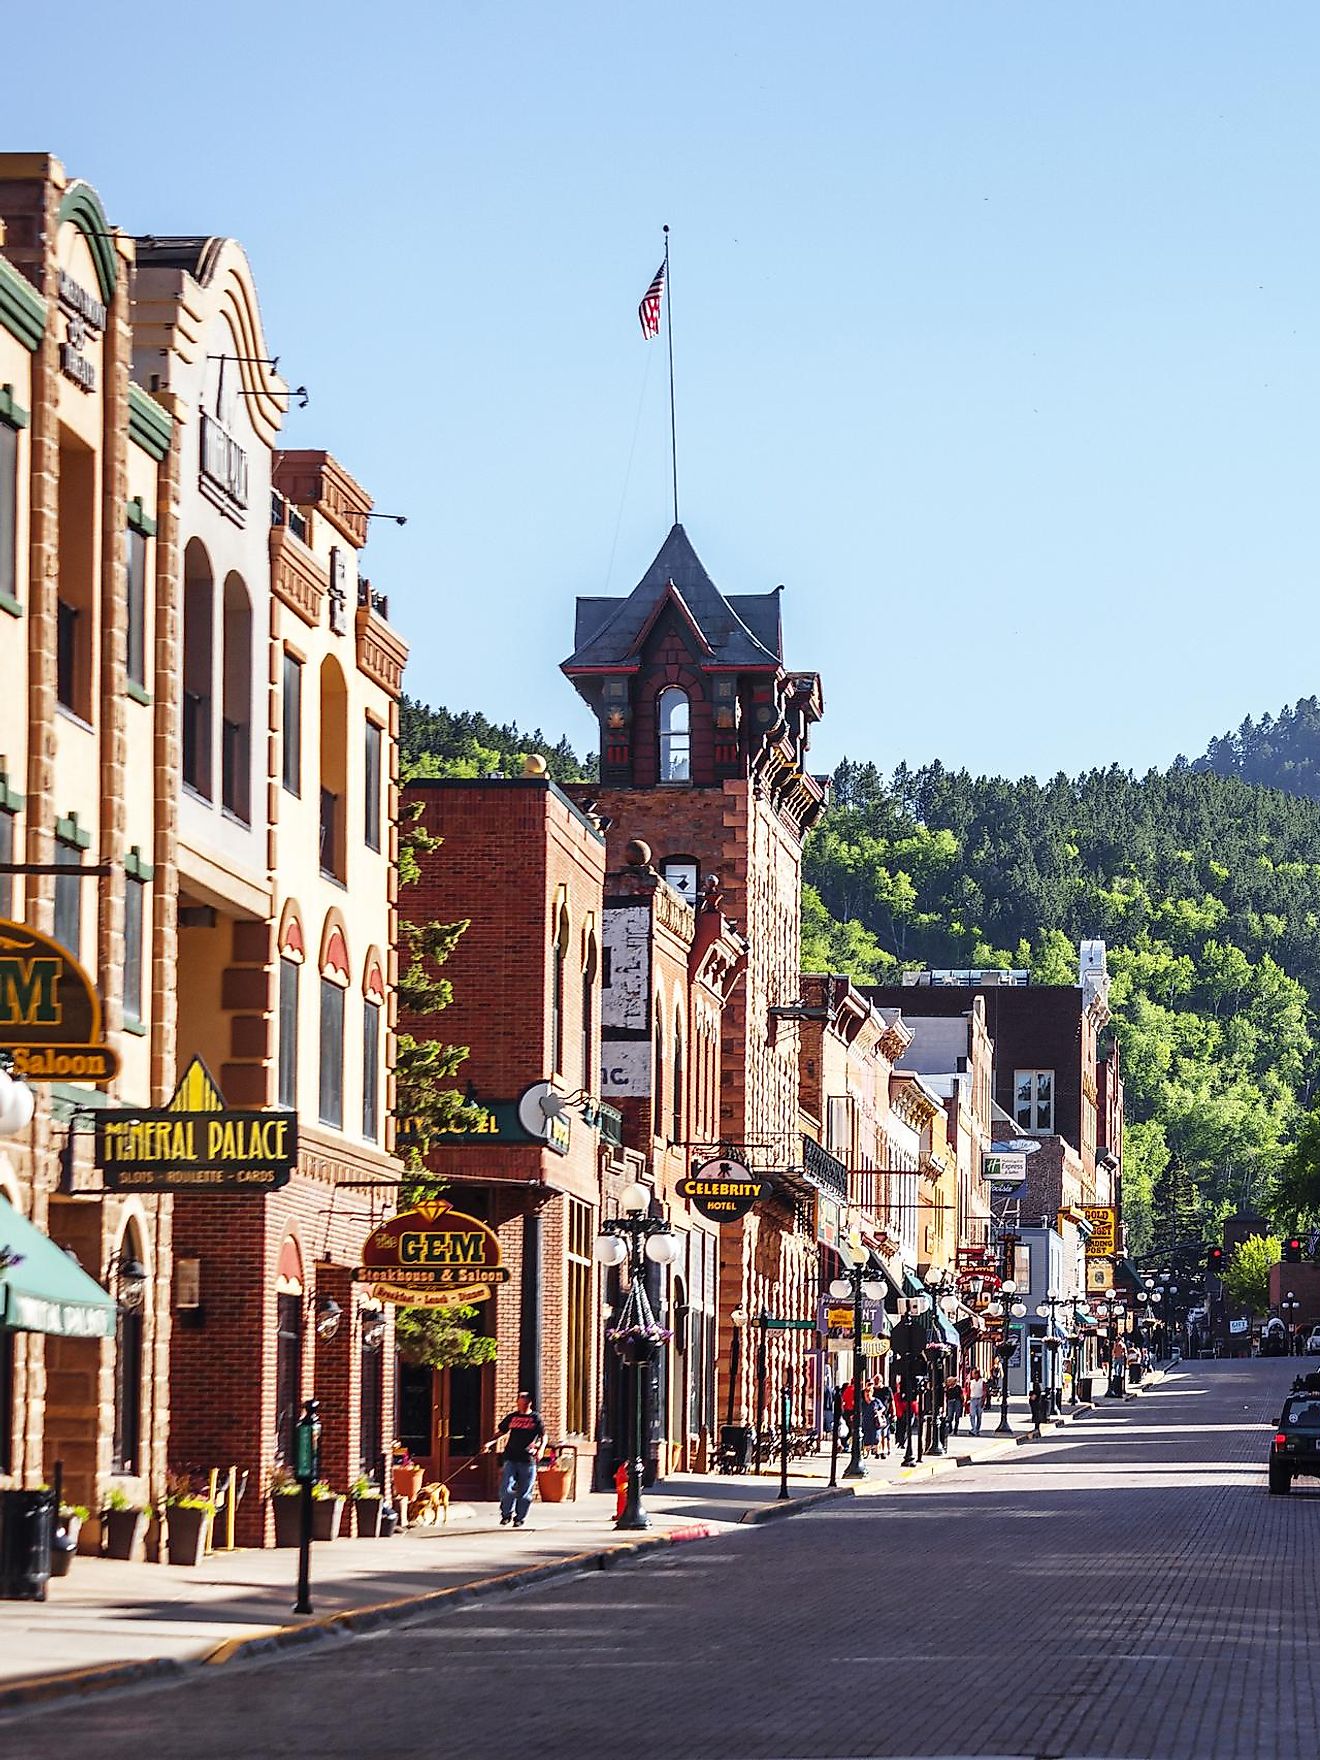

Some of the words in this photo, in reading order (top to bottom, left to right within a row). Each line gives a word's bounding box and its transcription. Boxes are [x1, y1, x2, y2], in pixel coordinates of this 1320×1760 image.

[13, 1048, 107, 1075] Saloon
[105, 1121, 199, 1161] MINERAL
[207, 1120, 289, 1160] PALACE
[119, 1171, 154, 1184] SLOTS
[165, 1170, 224, 1184] ROULETTE
[236, 1170, 276, 1184] CARDS
[684, 1181, 762, 1196] CELEBRITY
[707, 1201, 737, 1210] HOTEL
[1085, 1211, 1109, 1220] GOLD
[399, 1231, 486, 1265] GEM
[357, 1268, 435, 1282] Steakhouse
[441, 1269, 453, 1281] &
[458, 1268, 504, 1282] Saloon
